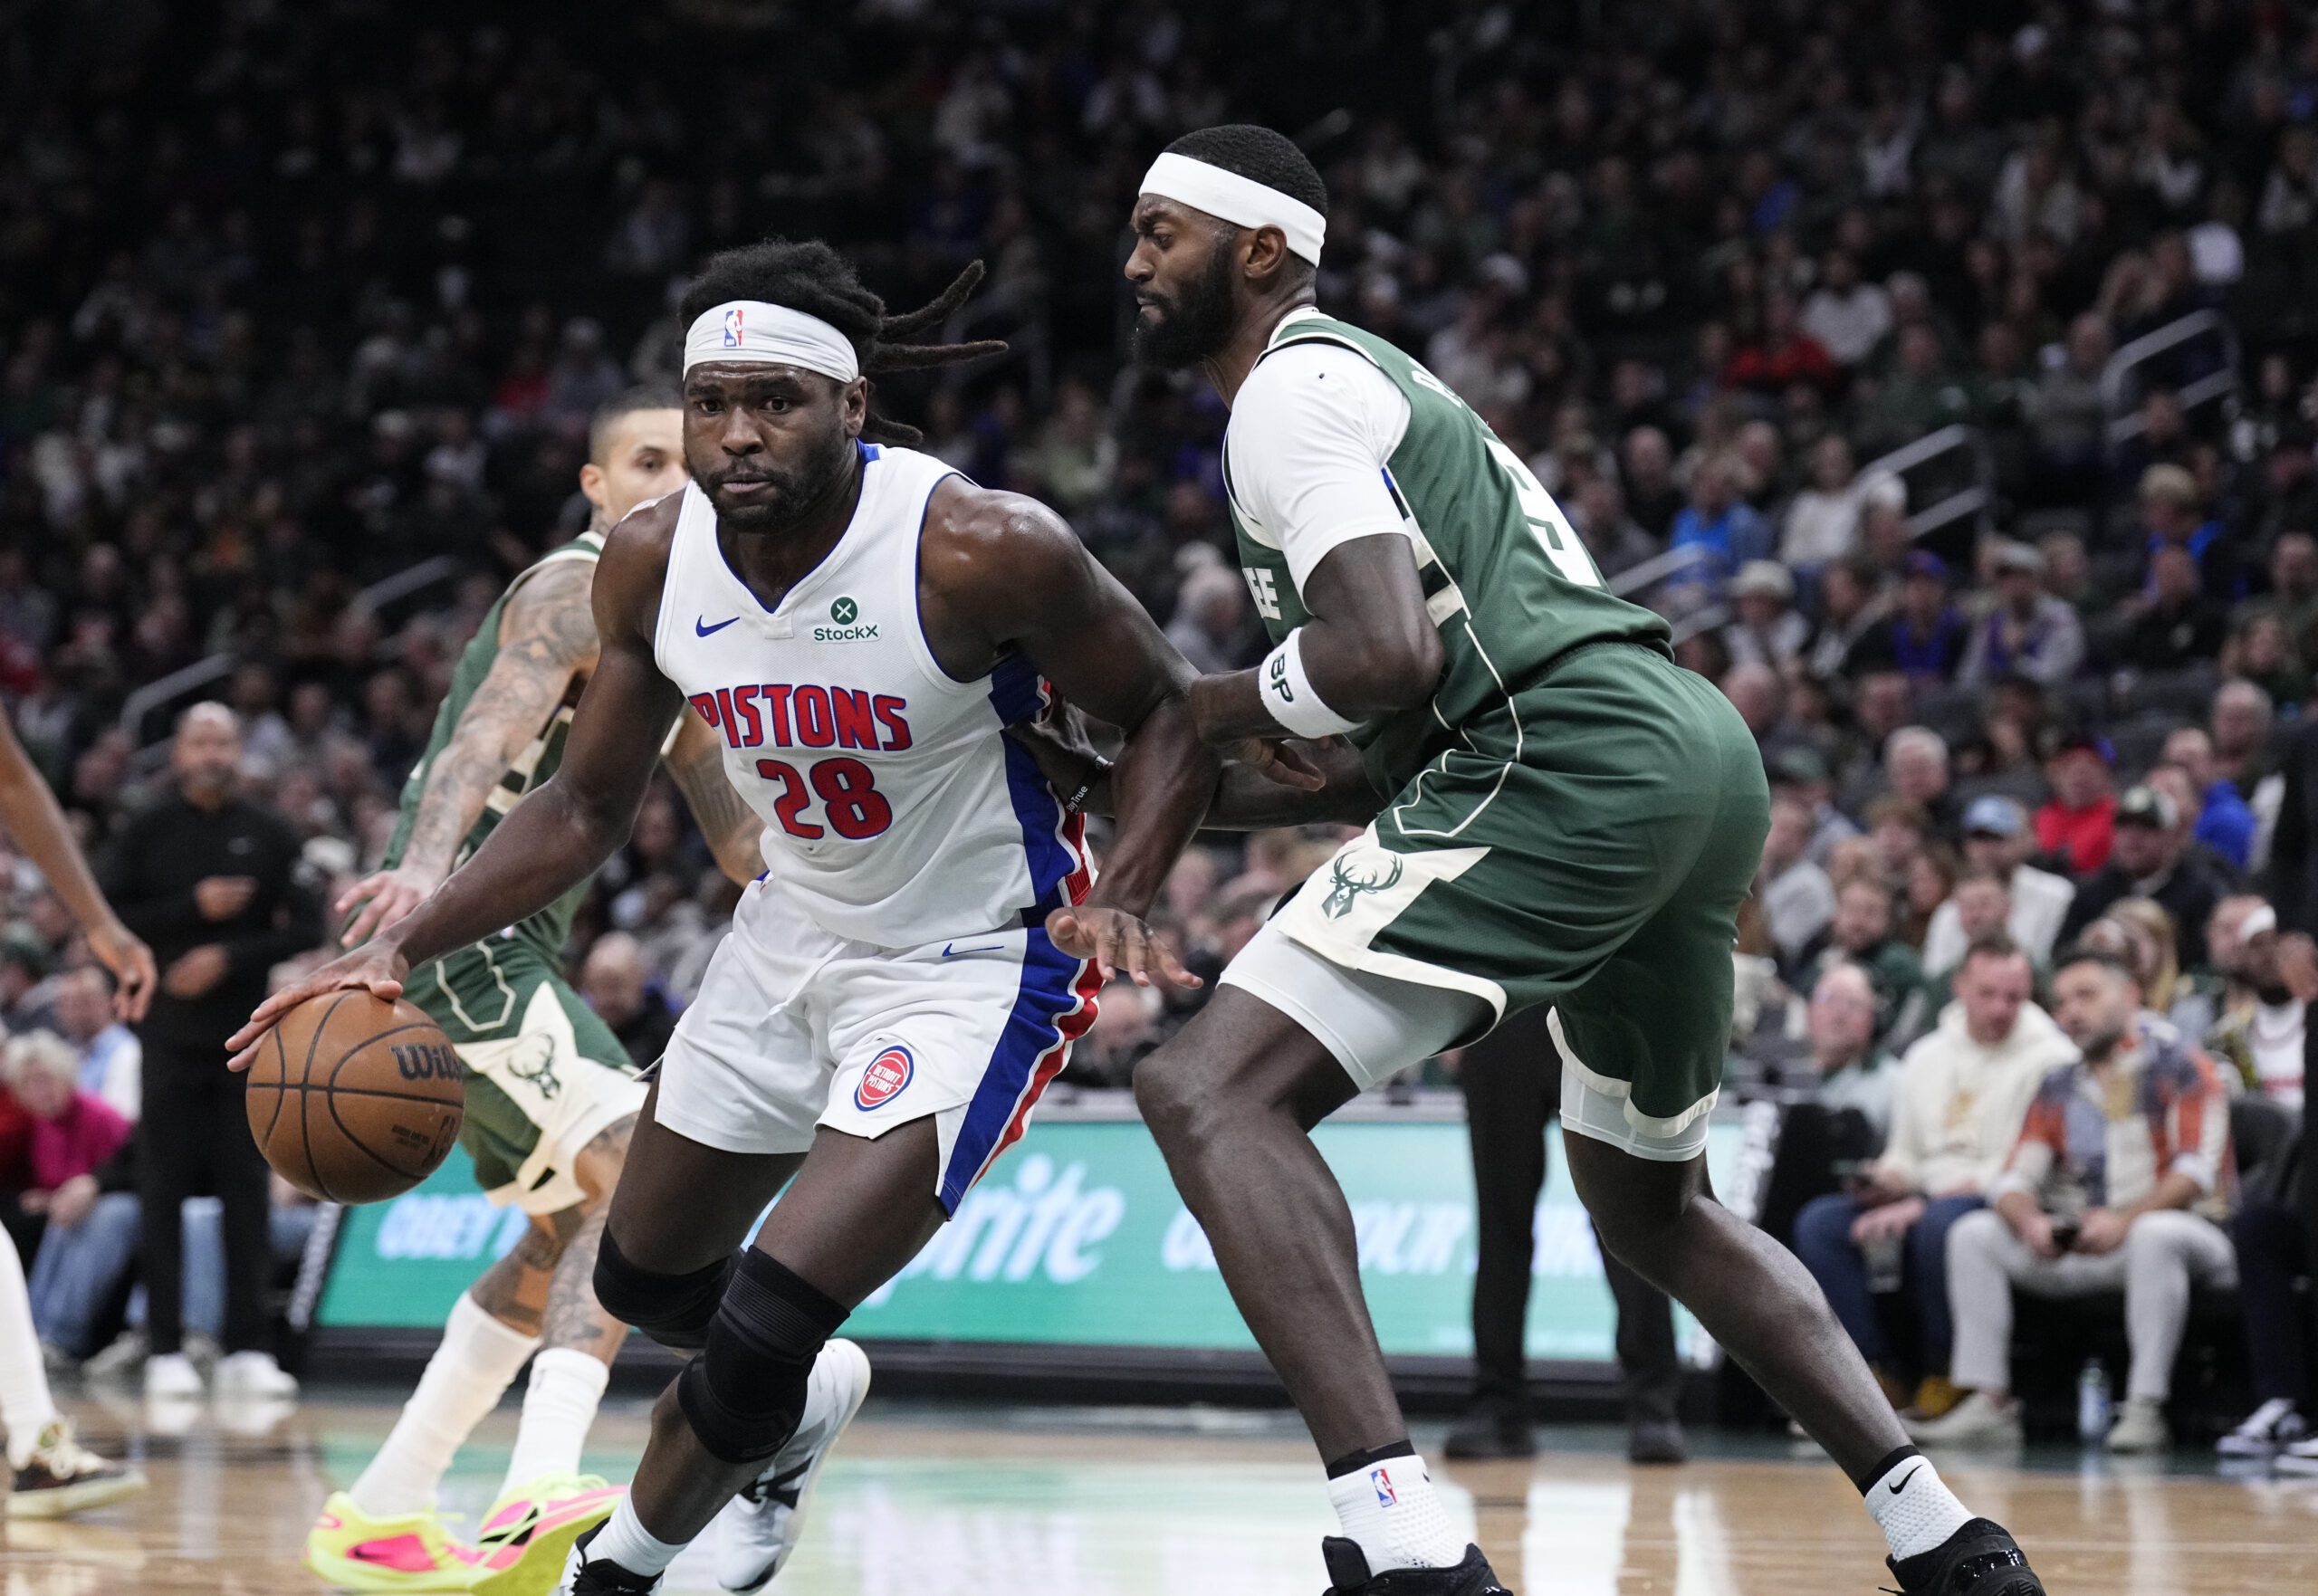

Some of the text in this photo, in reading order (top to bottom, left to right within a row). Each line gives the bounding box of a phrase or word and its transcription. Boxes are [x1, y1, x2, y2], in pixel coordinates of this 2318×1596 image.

[813, 625, 878, 641] StockX
[1270, 653, 1294, 702] BP
[687, 683, 913, 751] PISTONS
[756, 757, 893, 840] 28
[865, 1074, 895, 1094] PISTONS
[872, 1064, 902, 1085] DETROIT
